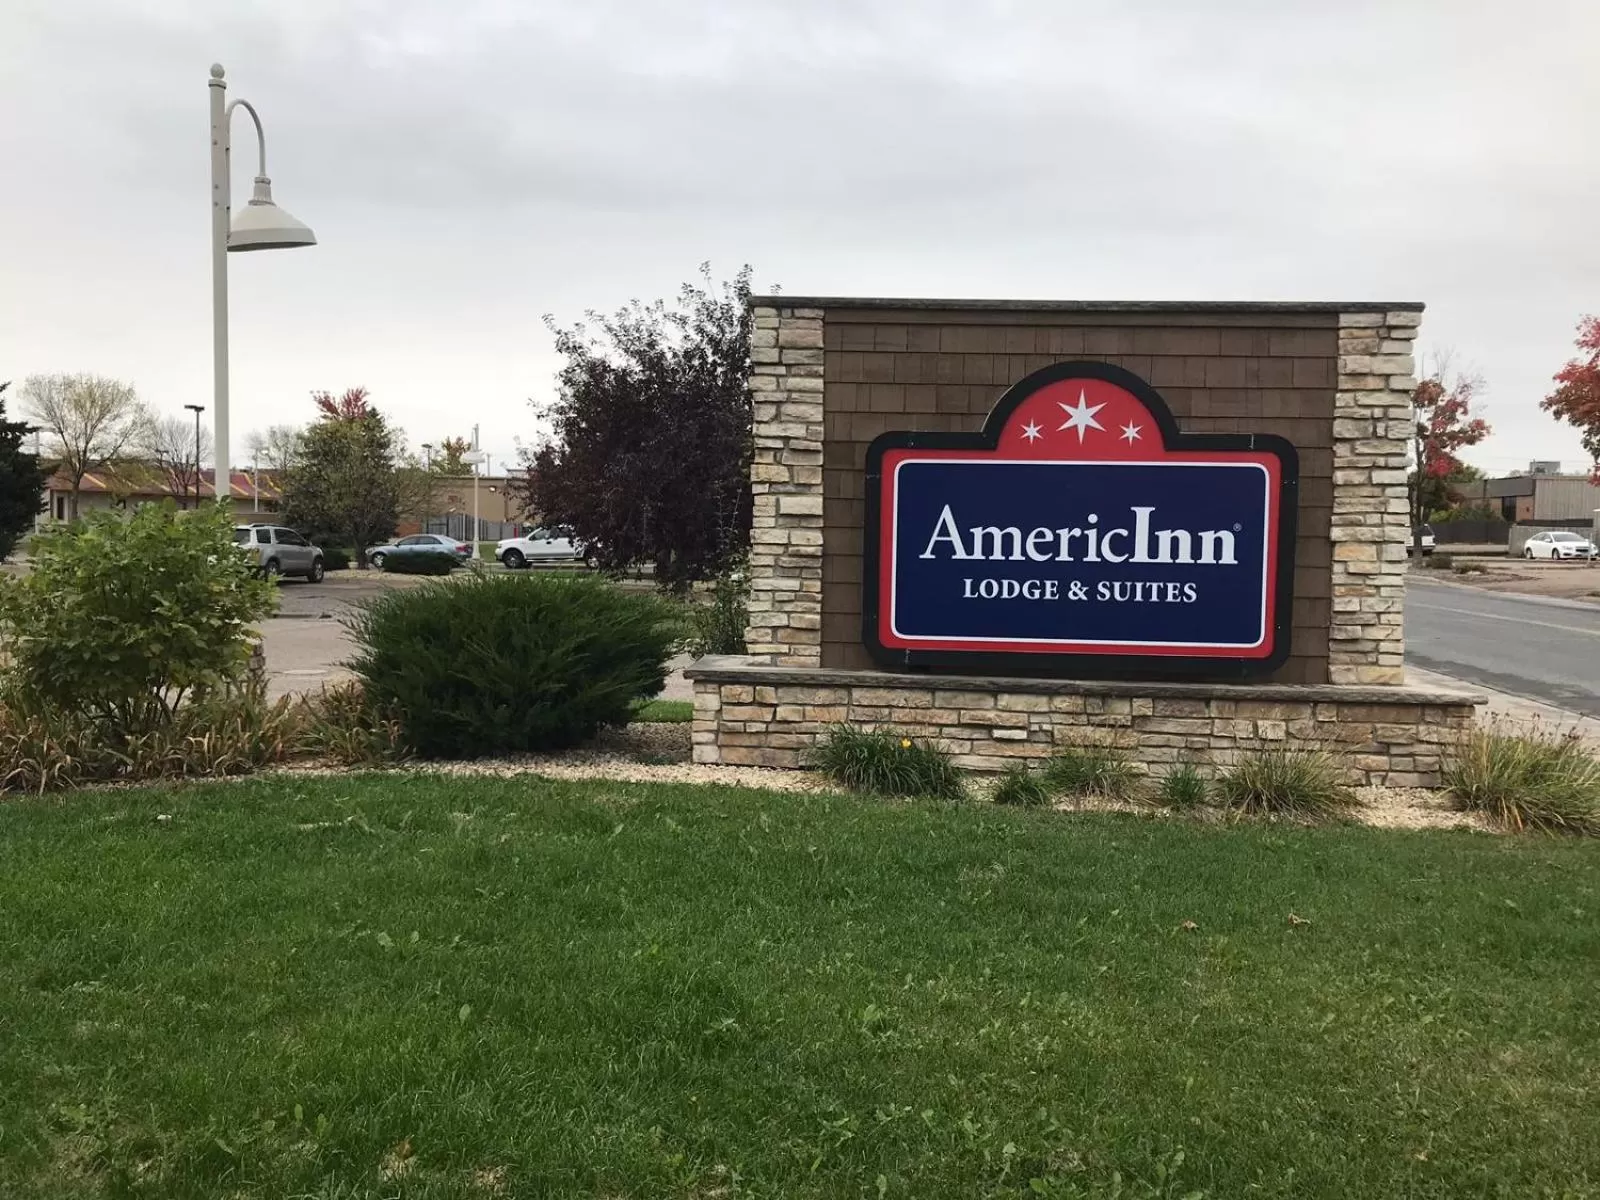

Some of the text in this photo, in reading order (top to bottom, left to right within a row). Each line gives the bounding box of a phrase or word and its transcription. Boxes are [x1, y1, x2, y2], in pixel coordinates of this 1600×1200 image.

[963, 578, 1197, 603] LODGE & SUITES
